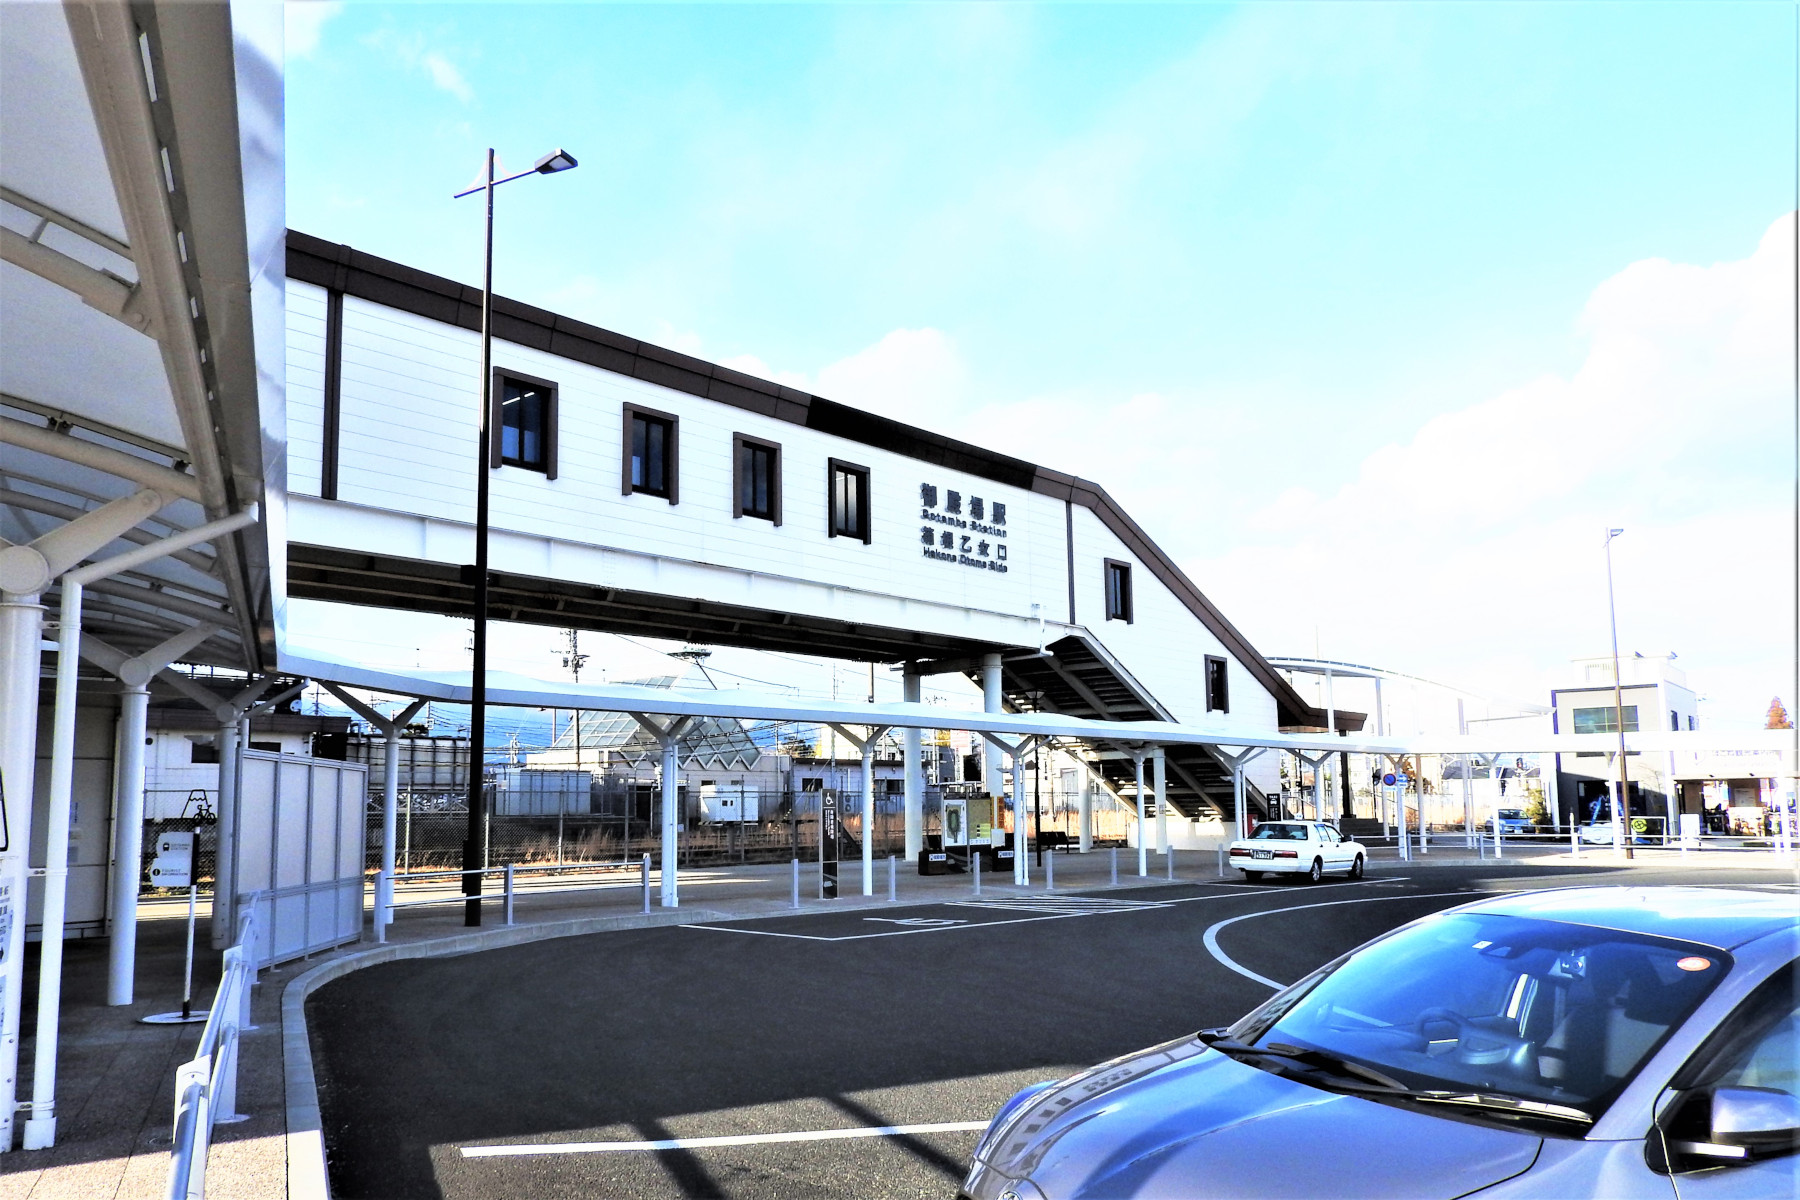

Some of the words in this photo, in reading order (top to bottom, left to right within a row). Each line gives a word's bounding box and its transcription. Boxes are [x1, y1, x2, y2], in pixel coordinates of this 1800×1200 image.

[920, 482, 1006, 526] 御殿場駅
[921, 509, 966, 529] Gotemba
[970, 520, 1007, 538] Station
[920, 526, 1007, 561] 箱根乙女口
[923, 546, 957, 563] Hakone
[958, 554, 987, 569] Otome
[988, 560, 1008, 574] Side
